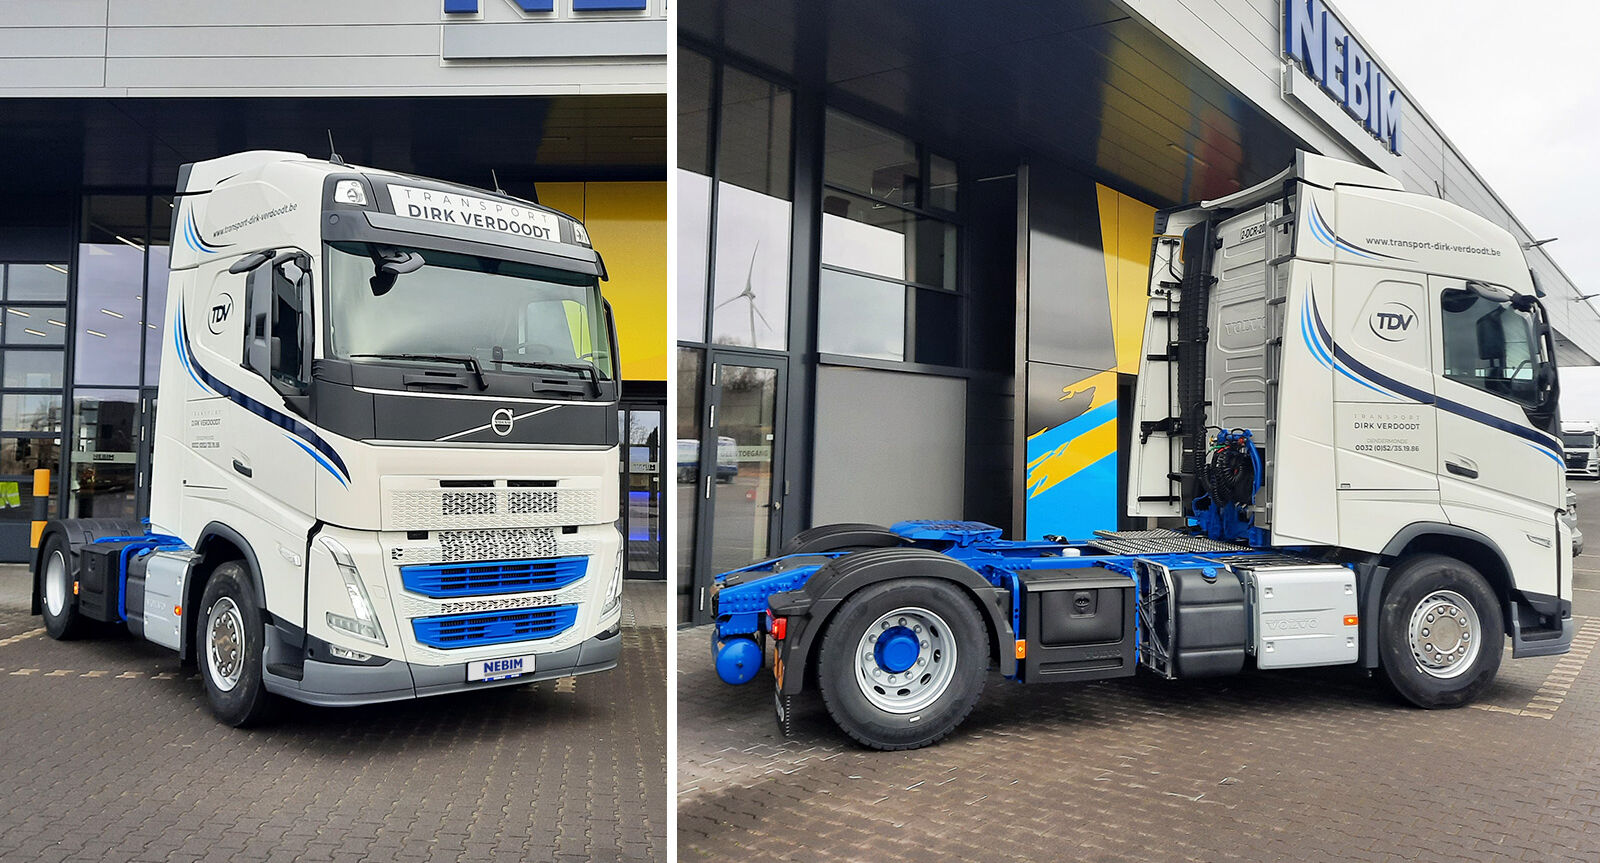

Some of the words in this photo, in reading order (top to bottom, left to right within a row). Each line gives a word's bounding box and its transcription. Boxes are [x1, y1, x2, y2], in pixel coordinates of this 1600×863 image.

[1286, 0, 1402, 157] NEBIM
[404, 189, 548, 224] TRANSPORT
[408, 204, 456, 223] DIRK
[460, 211, 551, 240] VERDOODT
[1366, 237, 1501, 256] www.transport-dirk-verdoodt.be
[212, 302, 231, 323] TDV
[1377, 313, 1413, 331] TDV
[1377, 422, 1420, 430] VERDOODT
[483, 658, 523, 673] NEBIM
